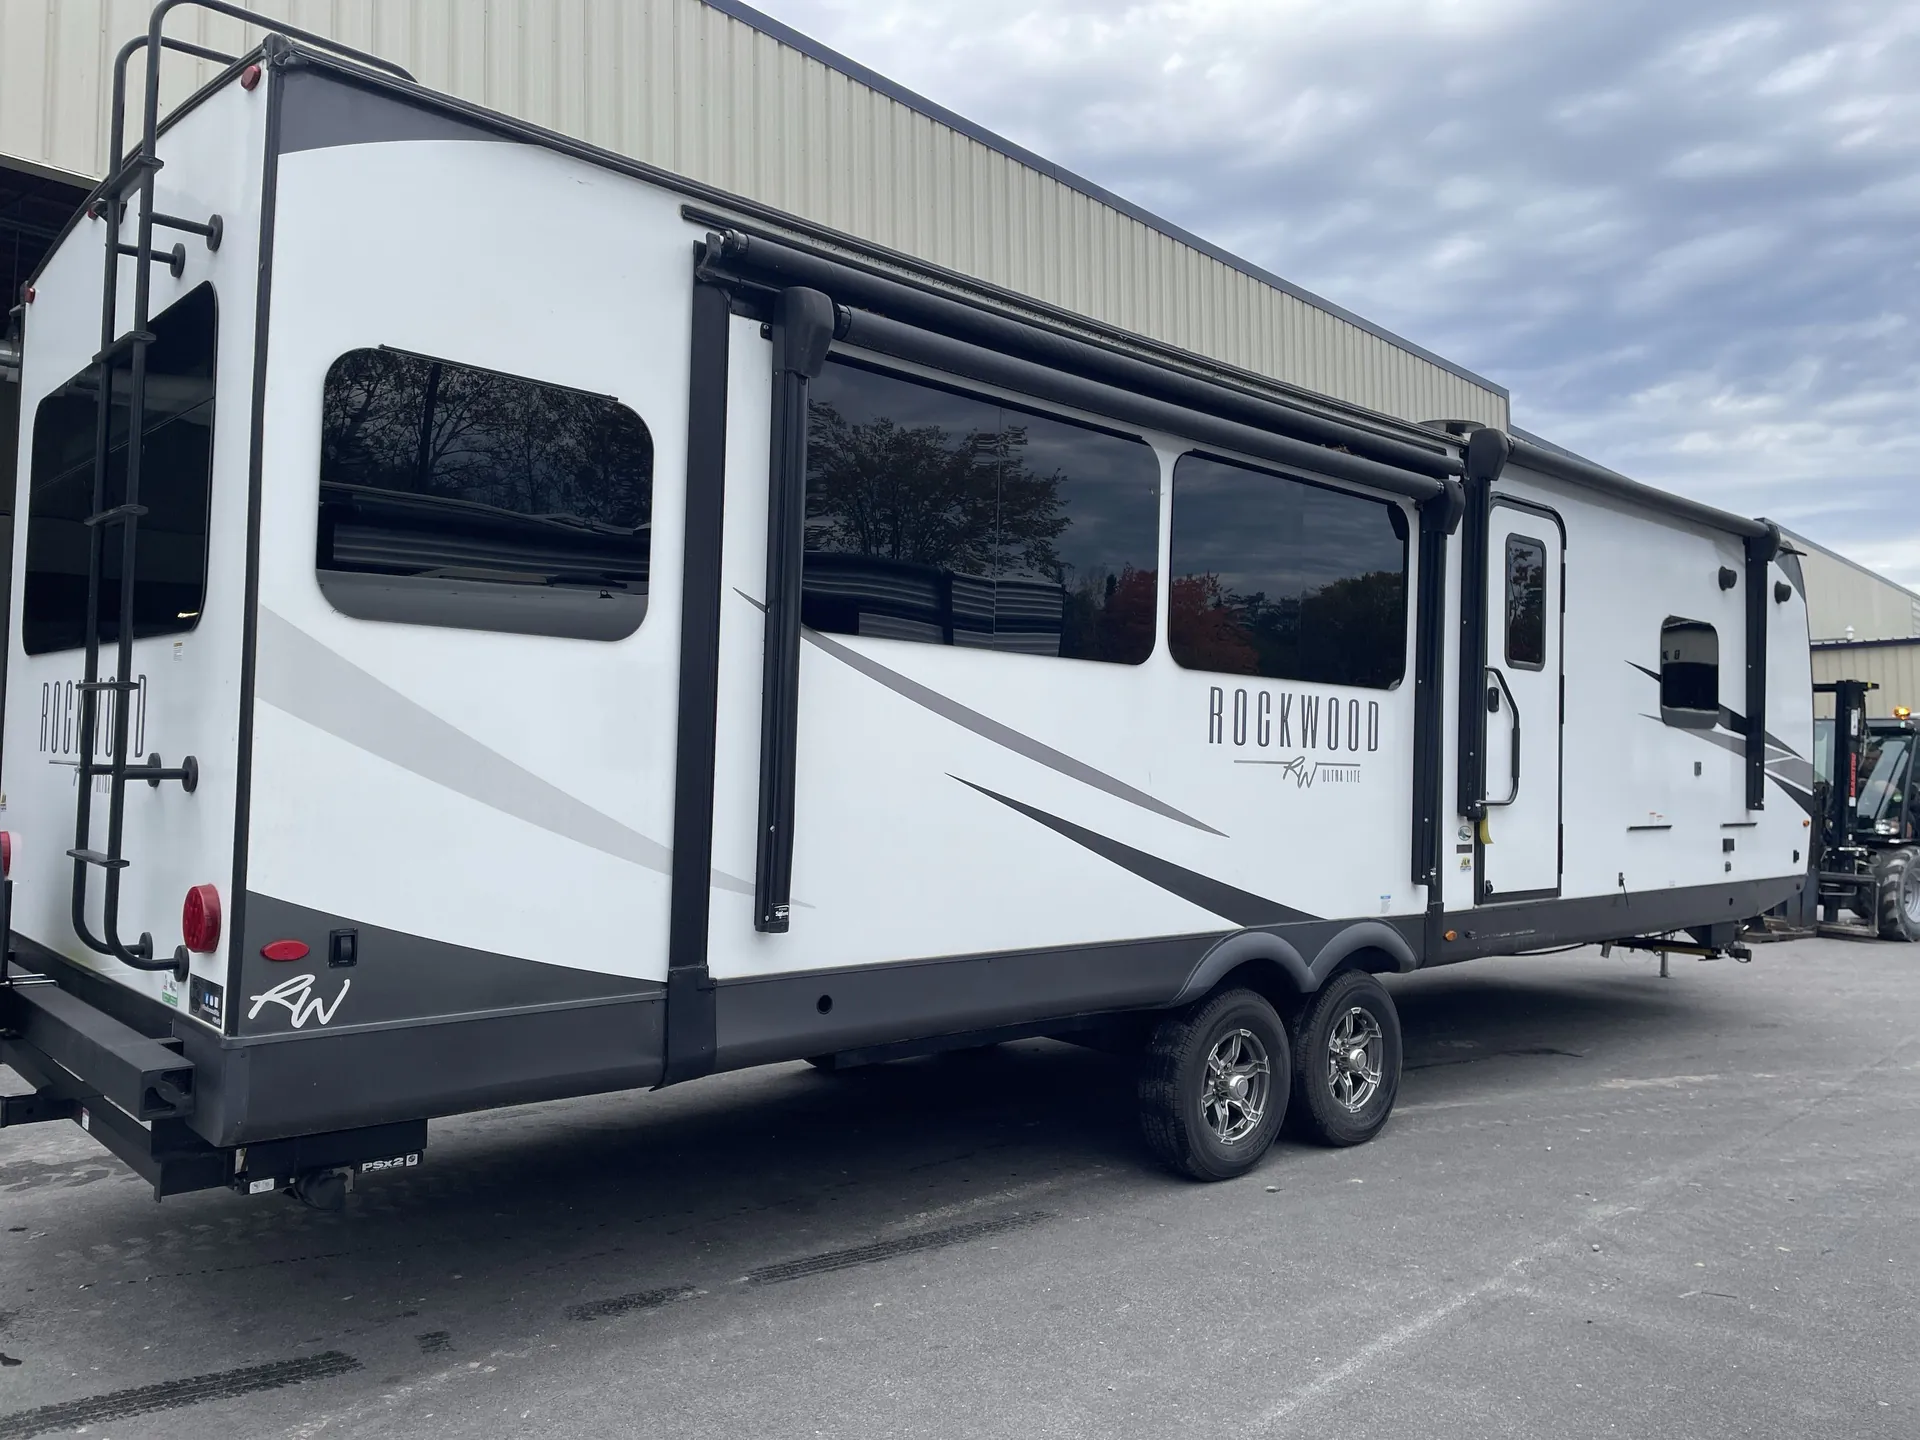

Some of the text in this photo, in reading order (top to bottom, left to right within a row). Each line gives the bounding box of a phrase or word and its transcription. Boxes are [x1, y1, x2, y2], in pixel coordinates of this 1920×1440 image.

[1208, 686, 1379, 752] ROCKWOOD
[1322, 769, 1343, 783] ULTRA
[1346, 769, 1361, 784] LITE
[247, 974, 351, 1029] RW
